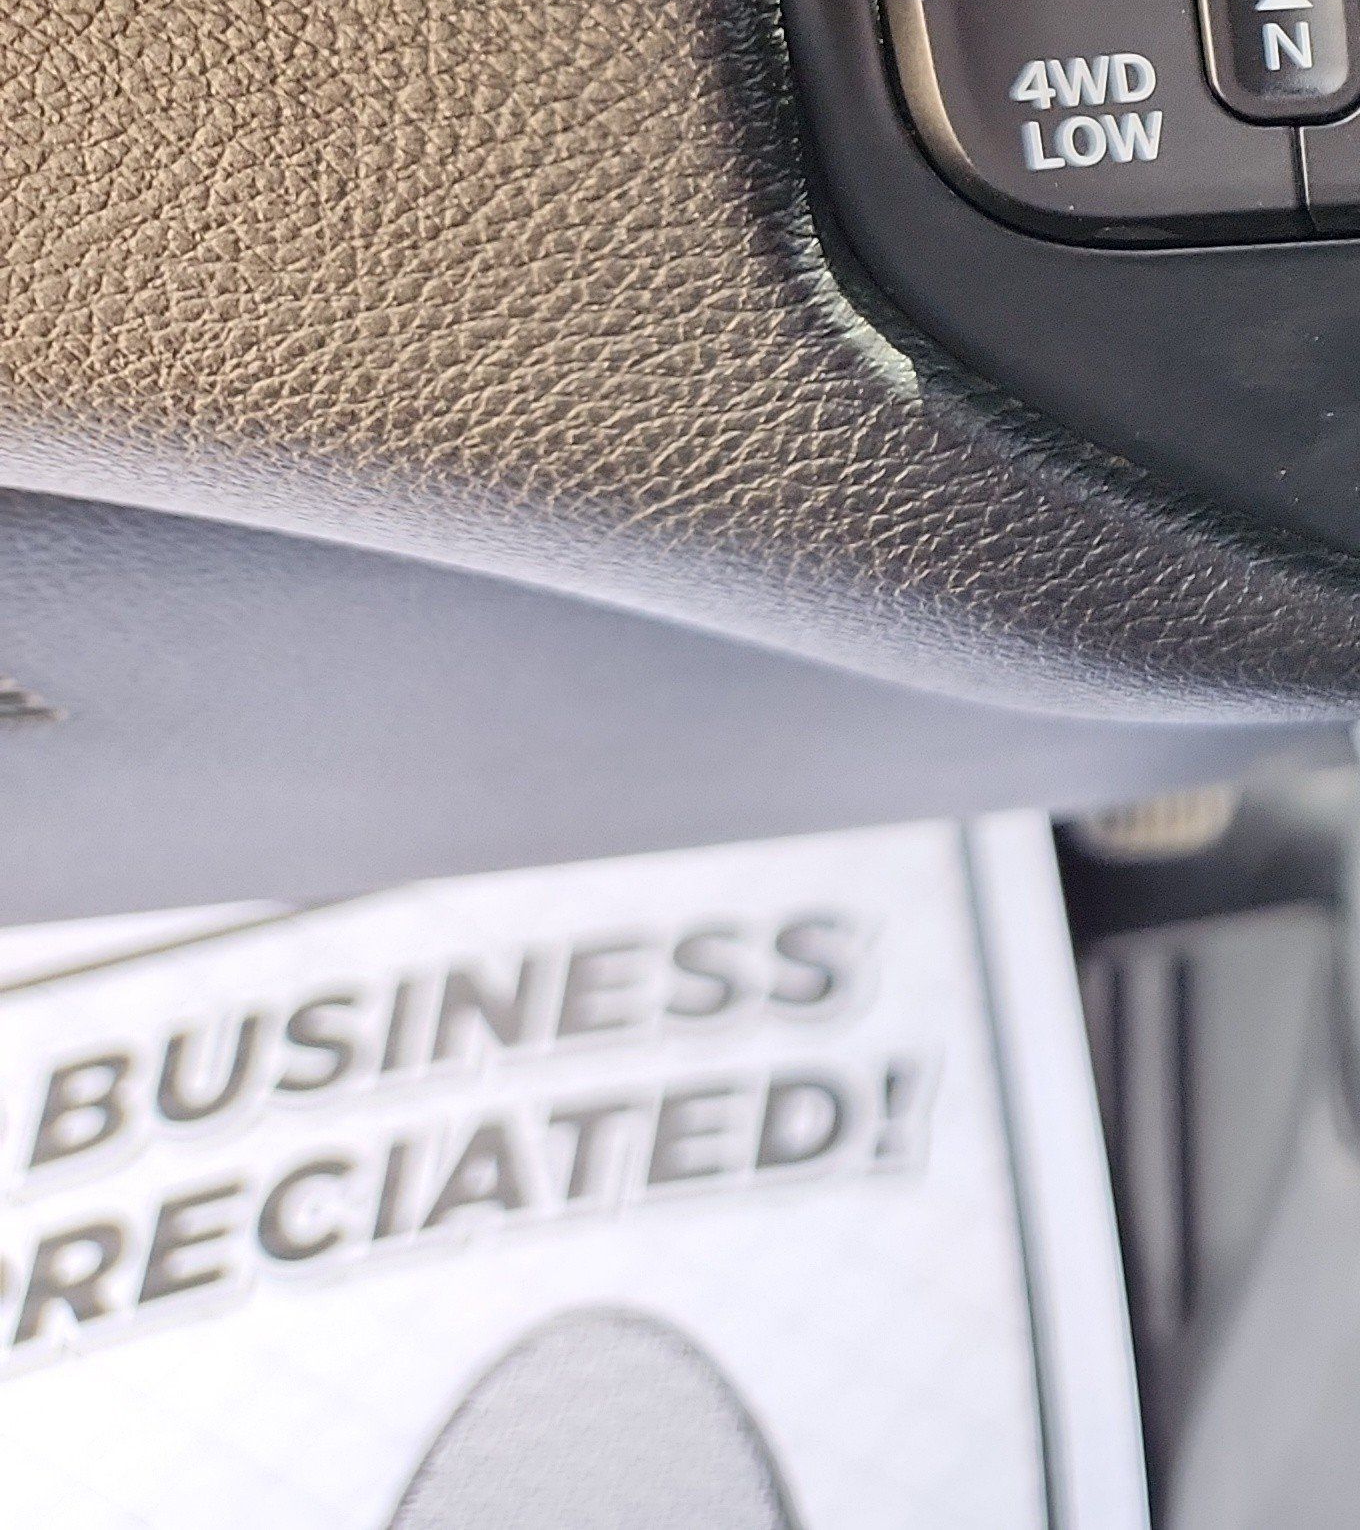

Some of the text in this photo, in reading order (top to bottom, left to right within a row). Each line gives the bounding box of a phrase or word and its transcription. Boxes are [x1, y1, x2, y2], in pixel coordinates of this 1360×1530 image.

[1263, 19, 1314, 72] N
[1012, 53, 1158, 111] 4WD
[1022, 111, 1164, 172] LOW
[27, 910, 852, 1169] BUSINESS
[0, 1058, 922, 1346] RECIATED!
